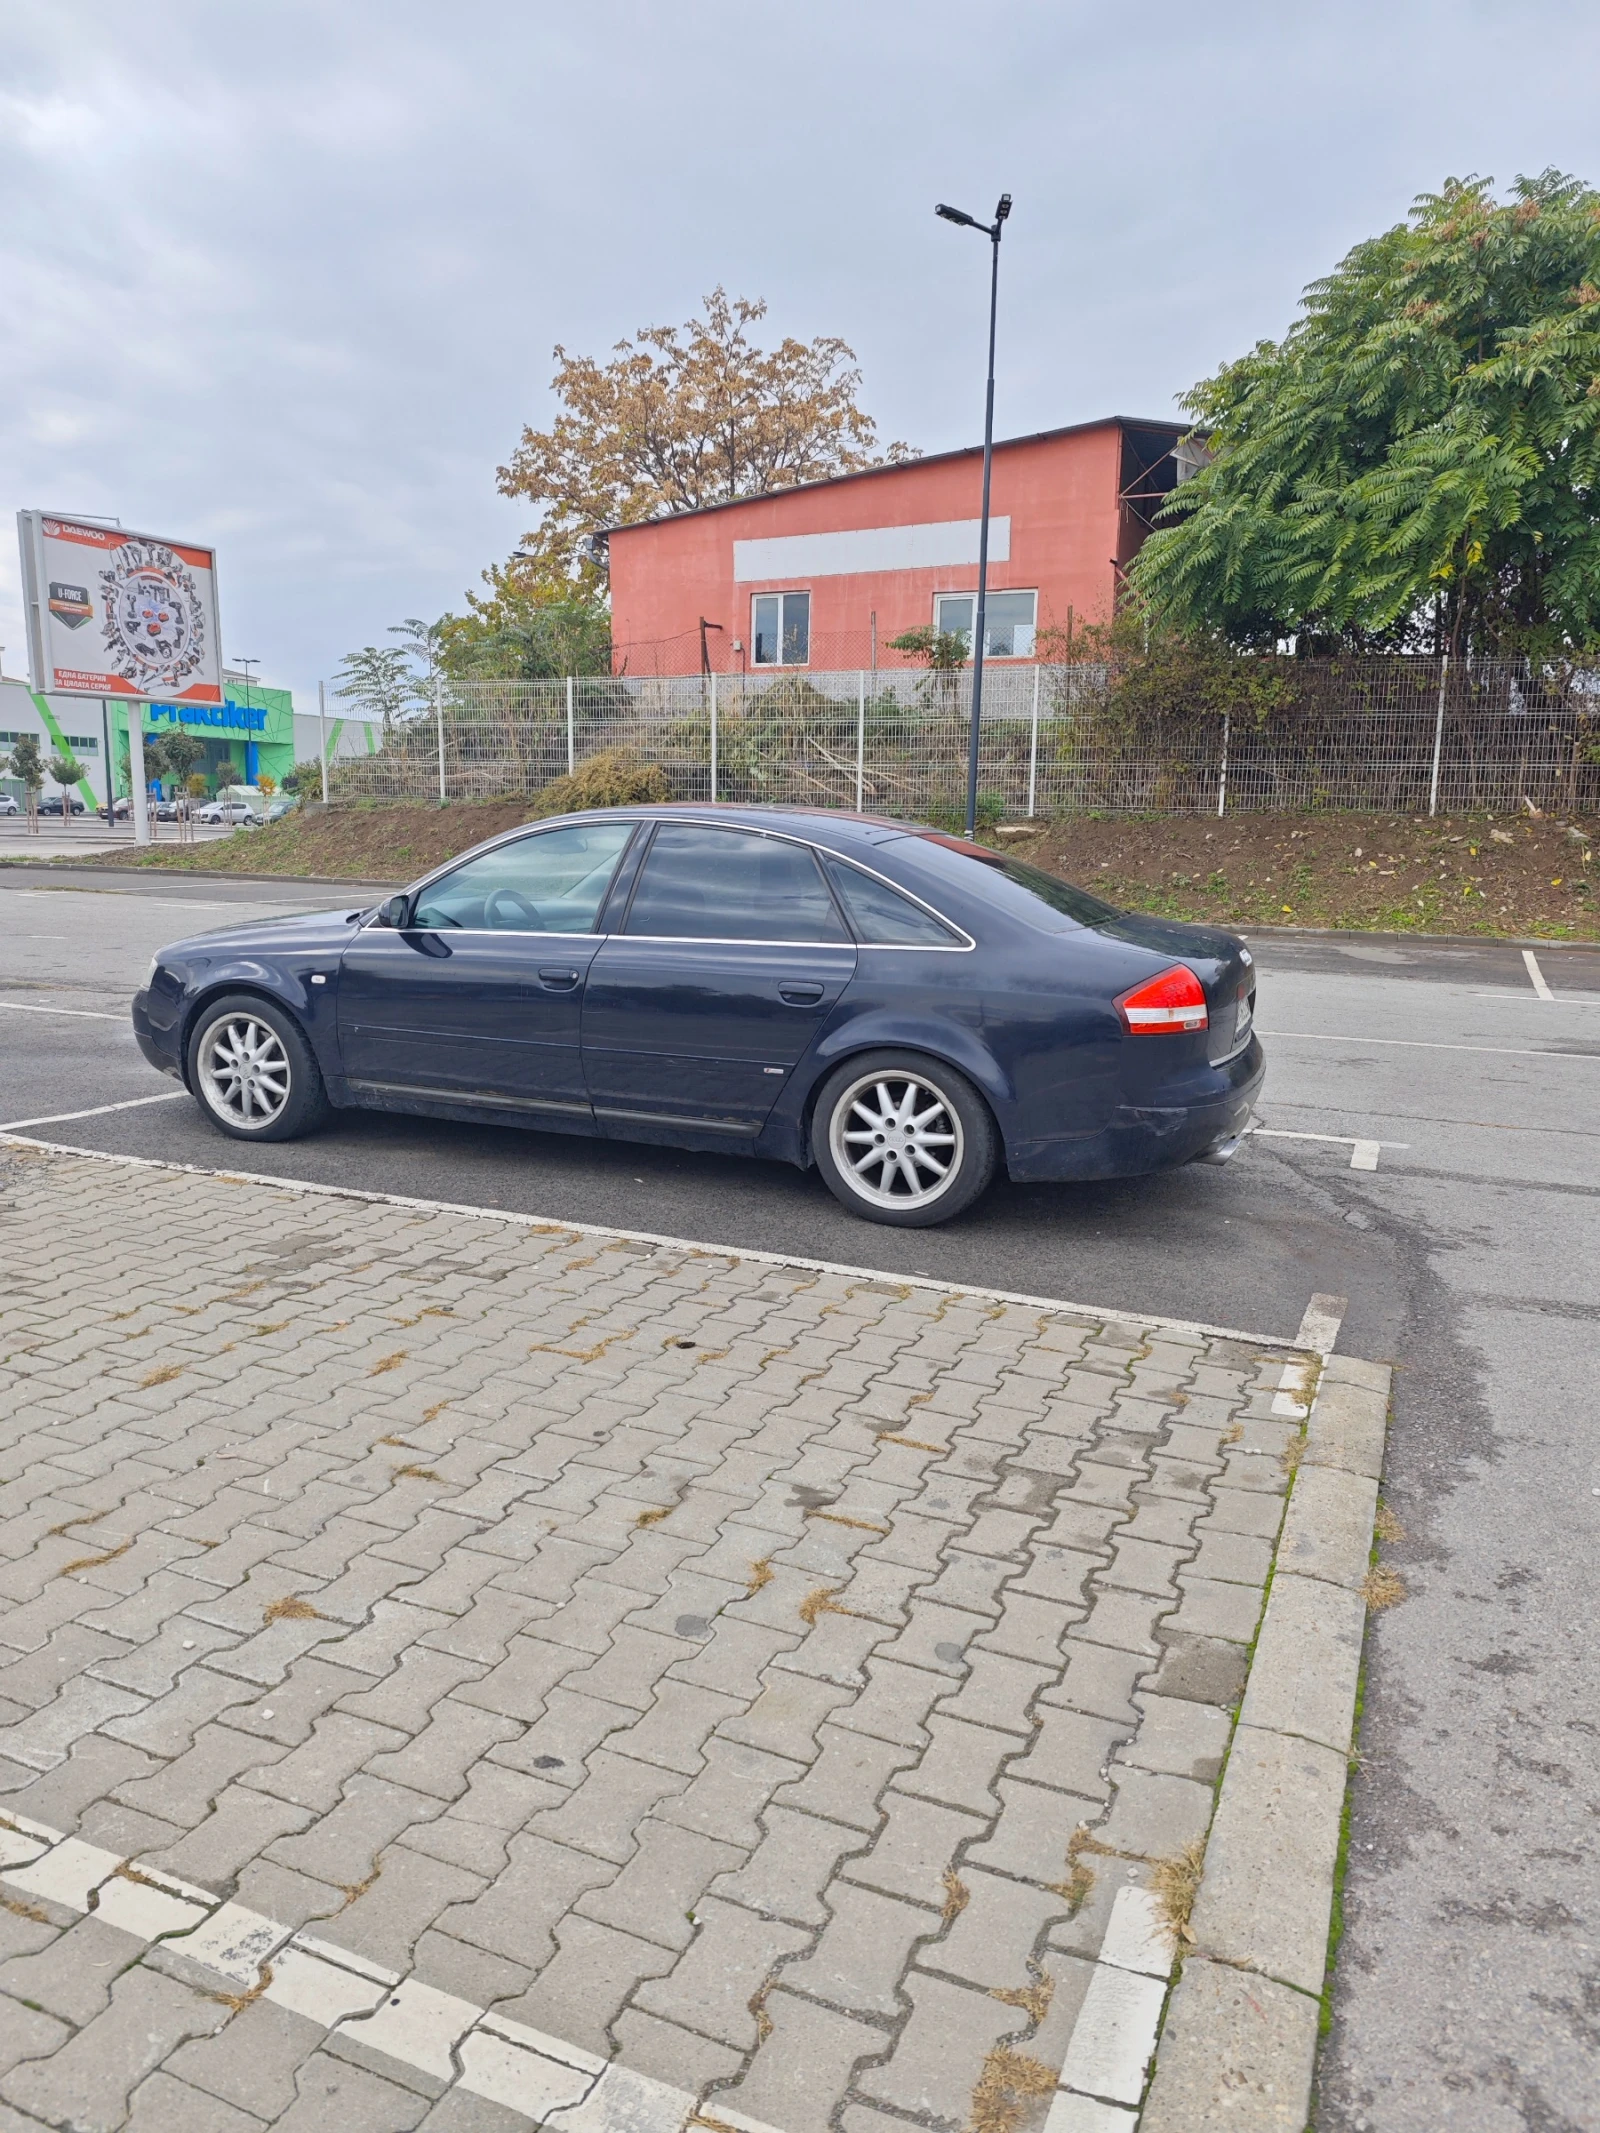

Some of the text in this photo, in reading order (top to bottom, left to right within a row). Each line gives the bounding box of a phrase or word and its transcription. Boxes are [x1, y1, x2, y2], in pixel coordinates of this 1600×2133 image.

[62, 524, 106, 541] DAEWOO
[57, 587, 82, 602] U-FORCE
[64, 680, 89, 688] ЦЯЛАТА
[78, 673, 106, 682] БАТЕРИЯ
[150, 698, 267, 731] Praktiker
